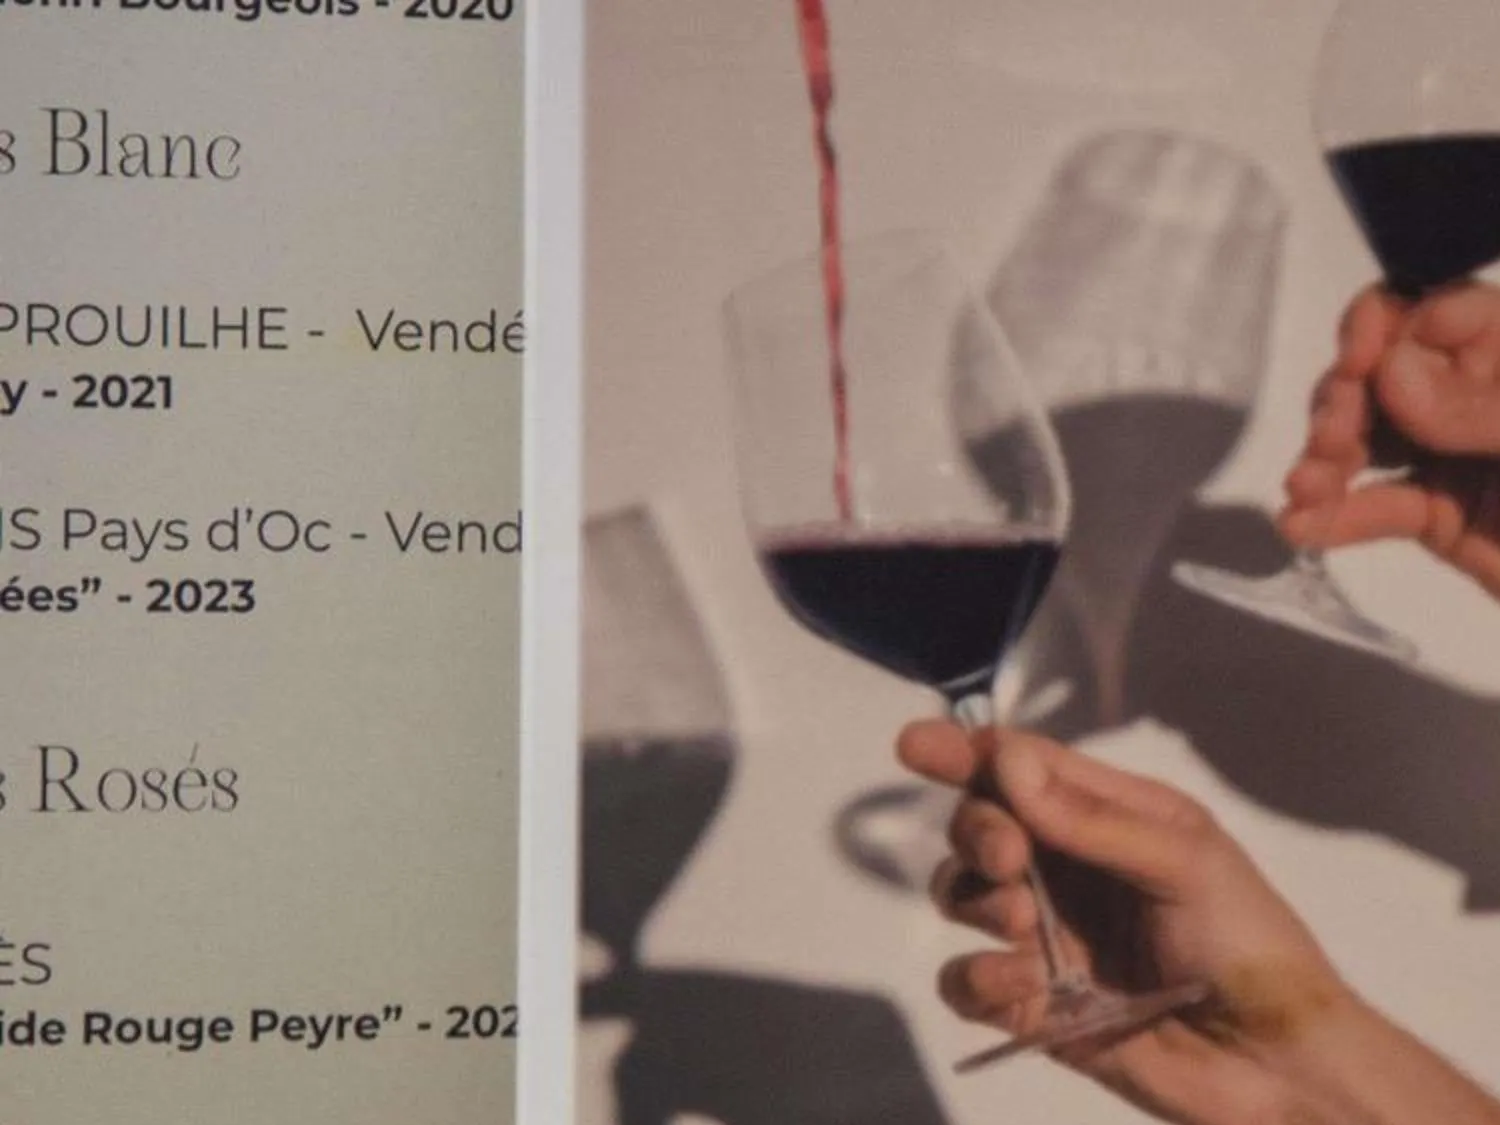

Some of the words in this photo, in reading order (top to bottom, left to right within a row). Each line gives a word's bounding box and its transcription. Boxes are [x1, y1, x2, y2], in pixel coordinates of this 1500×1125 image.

[41, 107, 242, 180] Blanc
[72, 373, 172, 410] 2021
[63, 508, 189, 563] Pays
[385, 509, 523, 554] Vend
[146, 578, 256, 613] 2023
[31, 742, 240, 814] Rosés
[83, 1011, 235, 1052] Rouge
[250, 1004, 403, 1051] Peyre”
